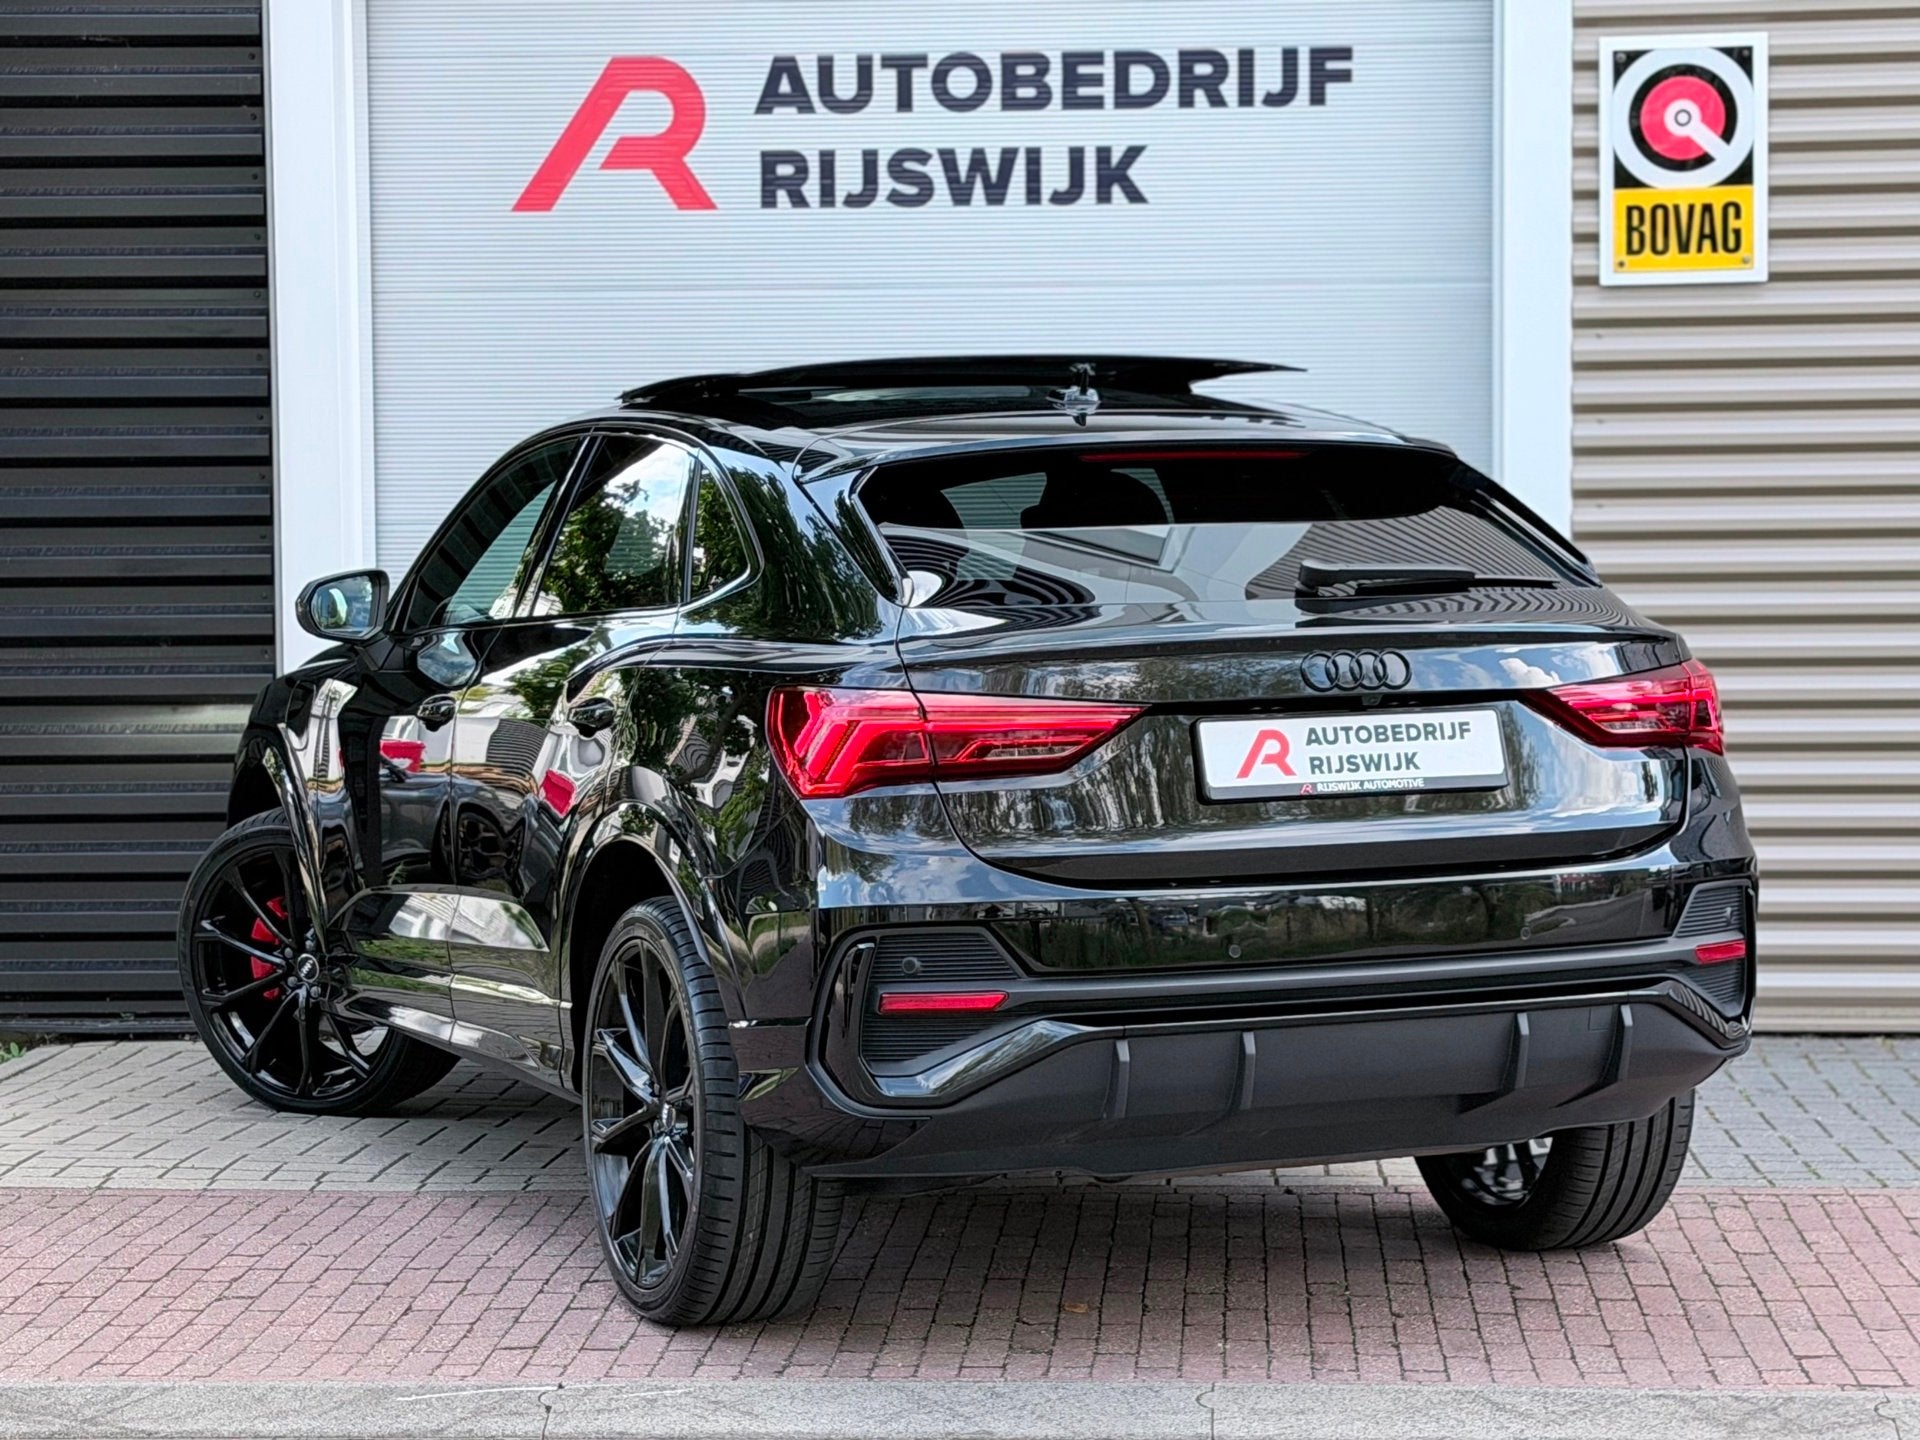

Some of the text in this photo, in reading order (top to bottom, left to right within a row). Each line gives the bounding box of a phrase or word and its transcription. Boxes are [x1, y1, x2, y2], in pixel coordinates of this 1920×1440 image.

[755, 46, 1353, 115] AUTOBEDRIJF
[759, 145, 1149, 209] RIJSWIJK
[1625, 201, 1742, 256] BOVAG
[1305, 721, 1472, 746] AUTOBEDRIJF
[1309, 752, 1421, 775] RIJSWIJK
[1316, 780, 1362, 792] RIJSWIJK
[1363, 778, 1425, 790] AUTOMOTIVE
